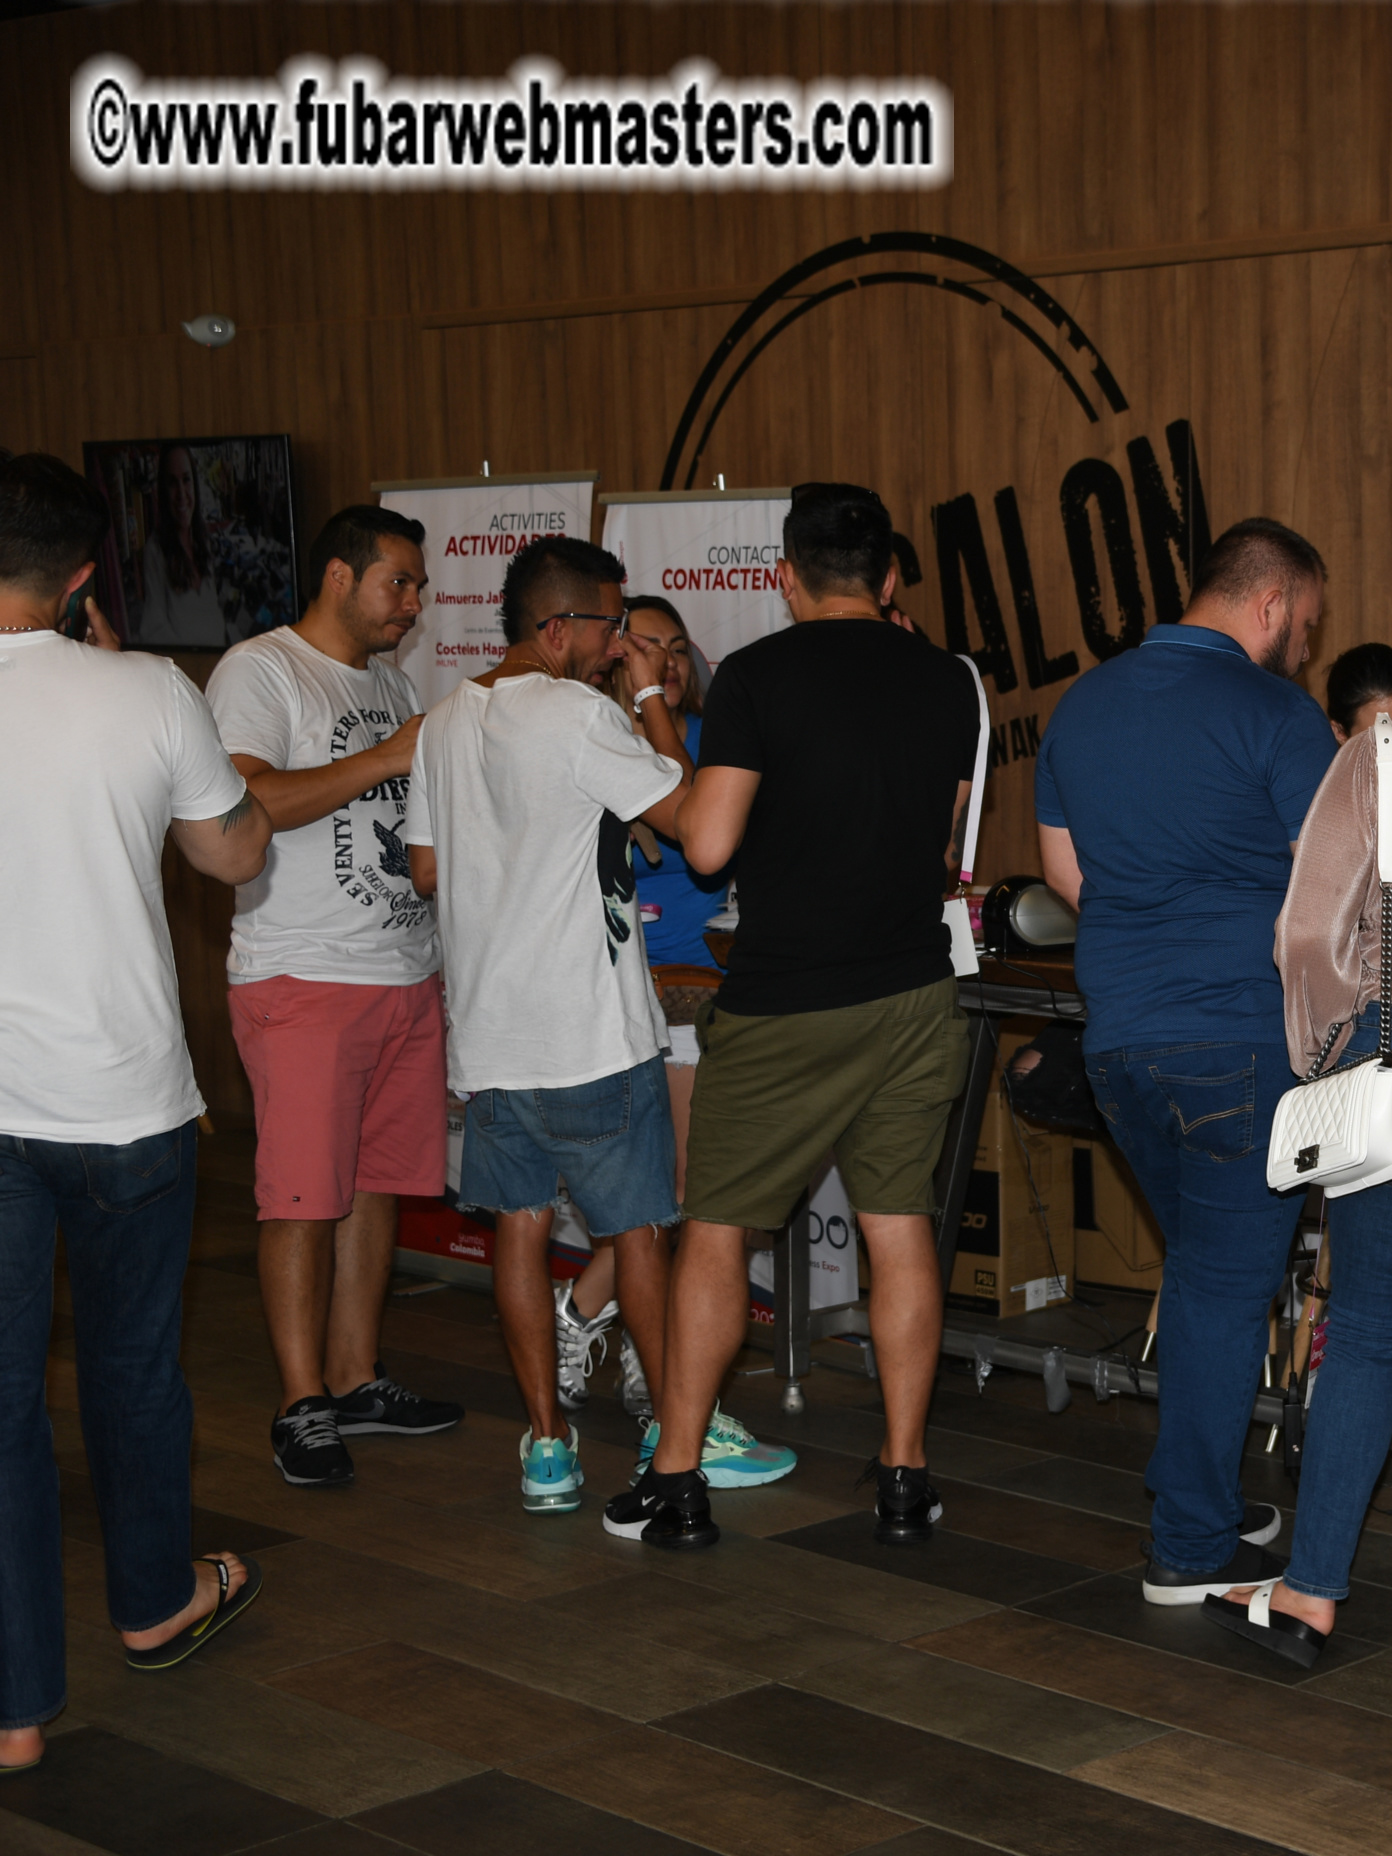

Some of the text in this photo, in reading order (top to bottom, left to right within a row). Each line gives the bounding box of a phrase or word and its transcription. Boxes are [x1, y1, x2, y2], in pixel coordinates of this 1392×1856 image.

[489, 511, 566, 531] ACTIVITIES
[444, 533, 567, 557] ACTIVIDA
[708, 546, 781, 565] CONTACT
[435, 592, 484, 605] Almuerzo
[436, 642, 480, 656] Cocteles
[358, 708, 396, 726] FOR
[382, 910, 428, 930] 1978
[450, 1242, 485, 1257] Colombia
[822, 1260, 840, 1273] Expo
[977, 1272, 994, 1285] PSU
